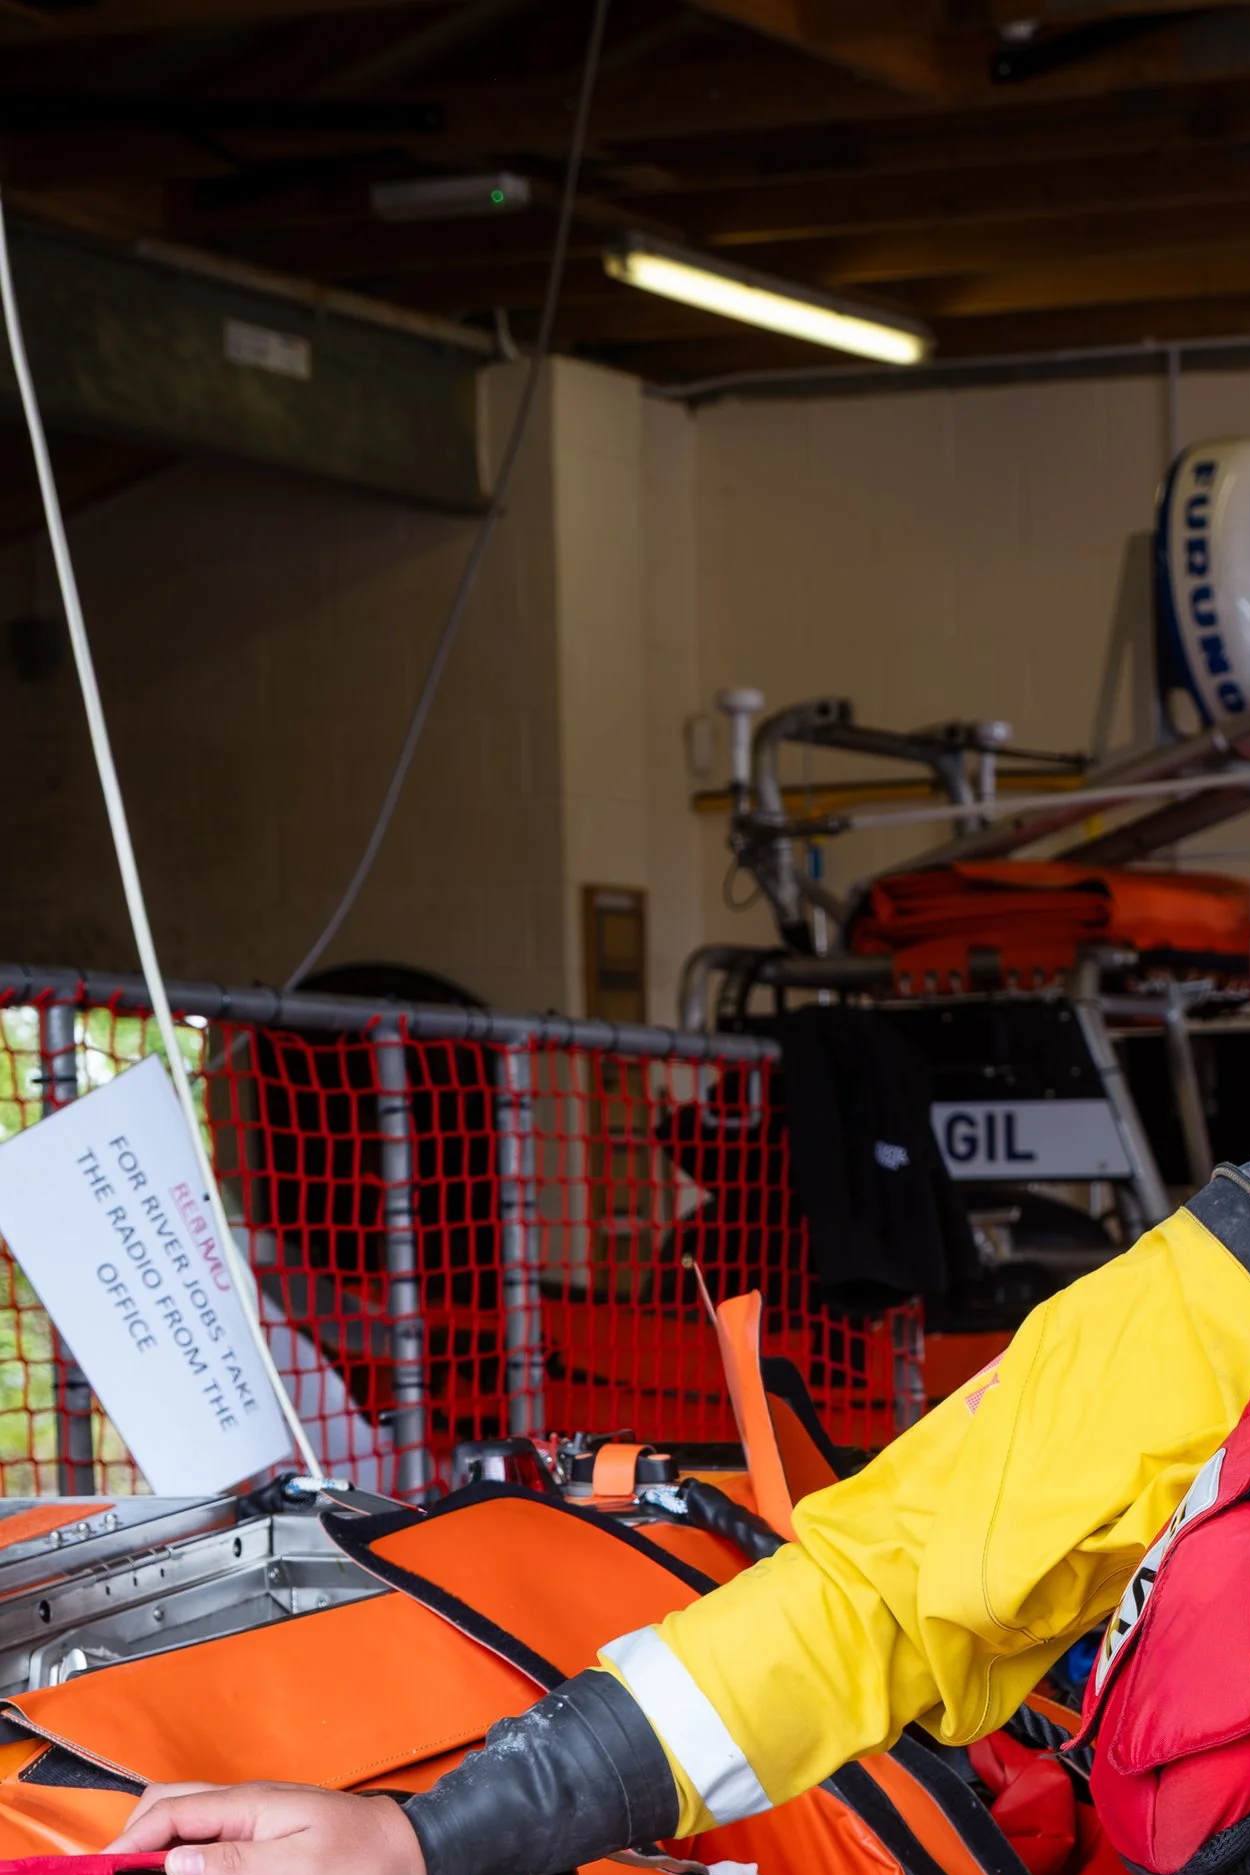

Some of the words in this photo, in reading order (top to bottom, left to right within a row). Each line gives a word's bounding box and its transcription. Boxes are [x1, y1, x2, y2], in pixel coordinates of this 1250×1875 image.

[944, 1111, 1038, 1164] GIL
[76, 1148, 118, 1203] THE
[106, 1205, 163, 1290] RADIO
[154, 1292, 209, 1376] FROM
[199, 1374, 240, 1432] THE
[97, 1262, 158, 1355] OFFICE
[109, 1135, 147, 1192] FOR
[142, 1194, 189, 1276] RIVER
[183, 1279, 225, 1343] JOBS
[218, 1344, 259, 1414] TAKE
